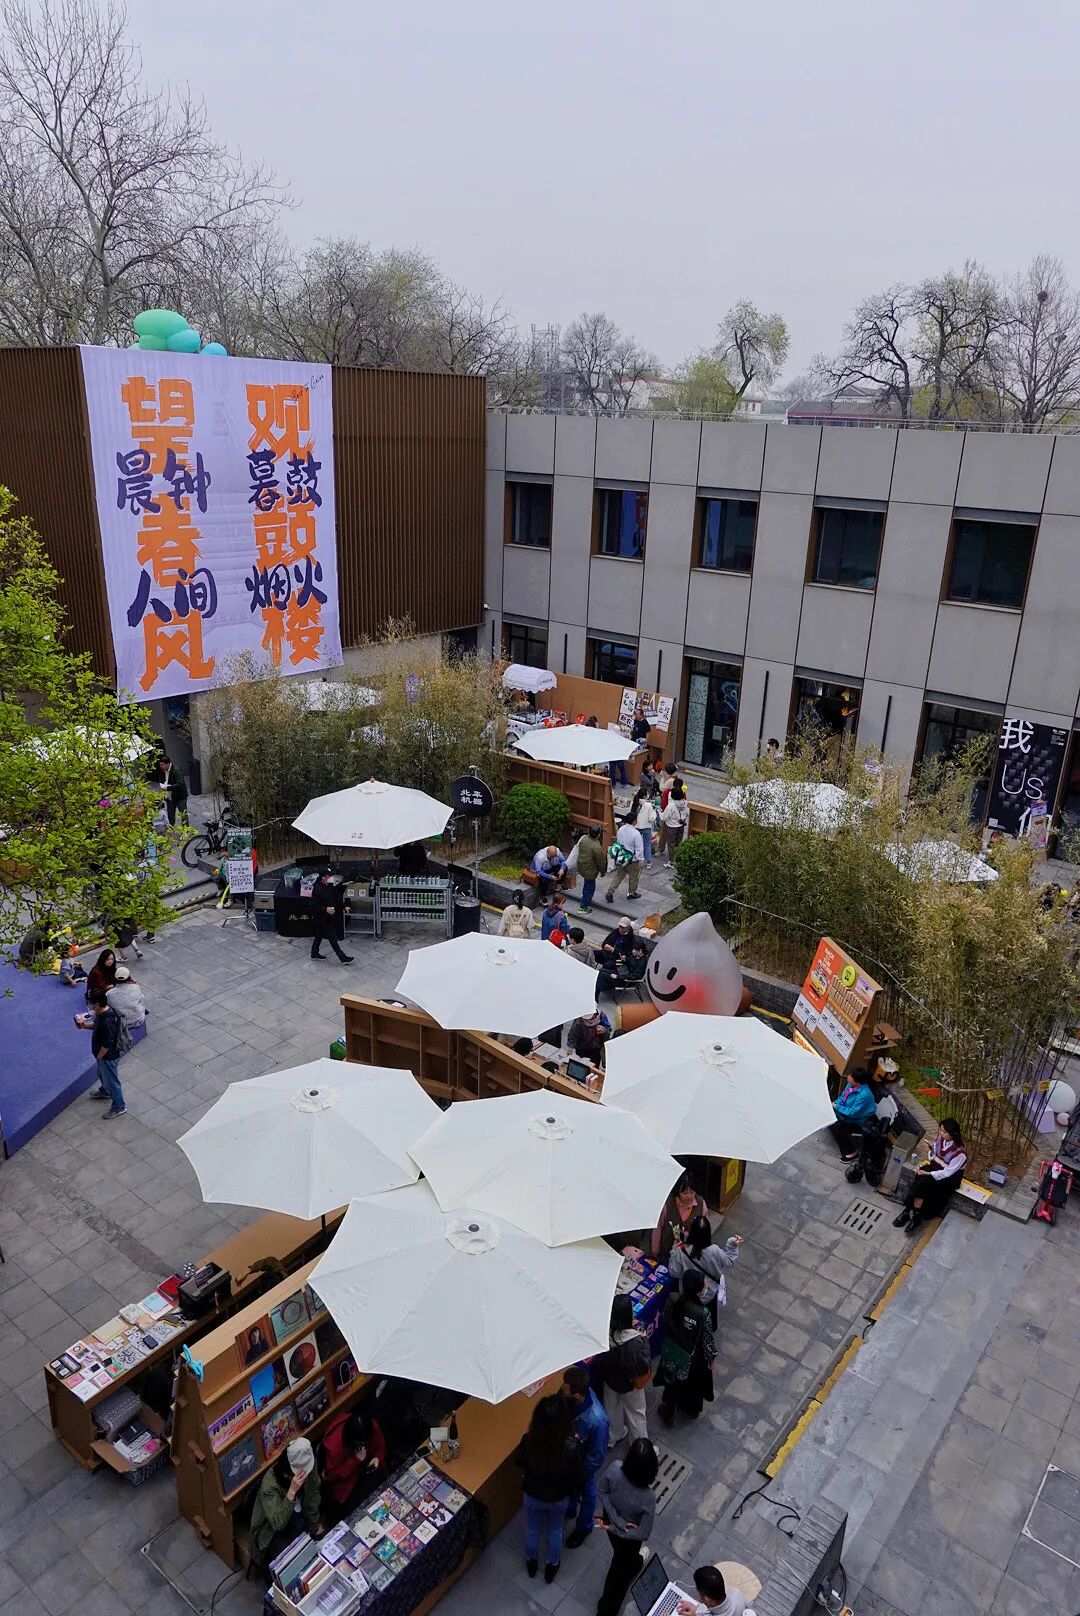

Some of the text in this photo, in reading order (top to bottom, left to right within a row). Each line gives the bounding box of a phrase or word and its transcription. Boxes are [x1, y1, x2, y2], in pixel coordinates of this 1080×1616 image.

[116, 448, 322, 515] 晨钟 暮鼓
[246, 384, 325, 667] 观鼓楼
[127, 555, 328, 627] 人间 烟火
[999, 718, 1034, 753] 我
